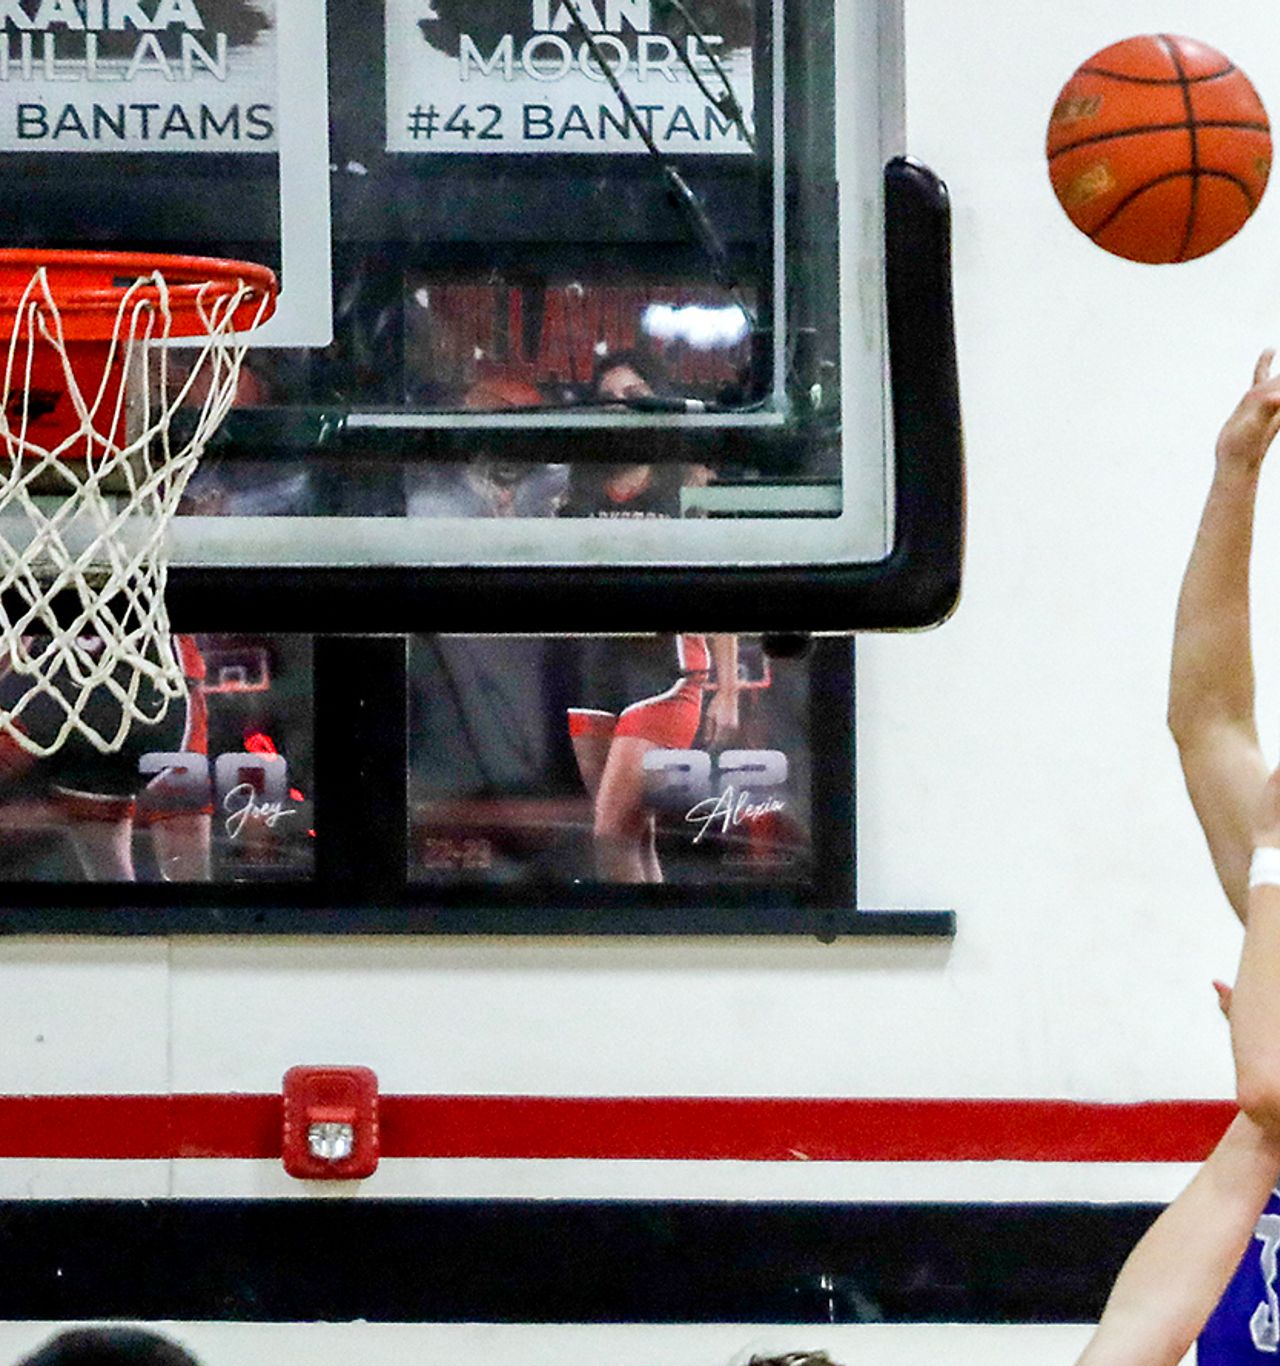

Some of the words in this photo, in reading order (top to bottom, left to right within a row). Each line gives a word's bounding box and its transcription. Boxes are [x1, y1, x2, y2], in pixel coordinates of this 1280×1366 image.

[531, 0, 651, 32] IAN
[458, 33, 724, 84] MOORE
[15, 102, 275, 142] BANTAMS
[406, 104, 504, 141] #42
[520, 104, 754, 142] BANTAM
